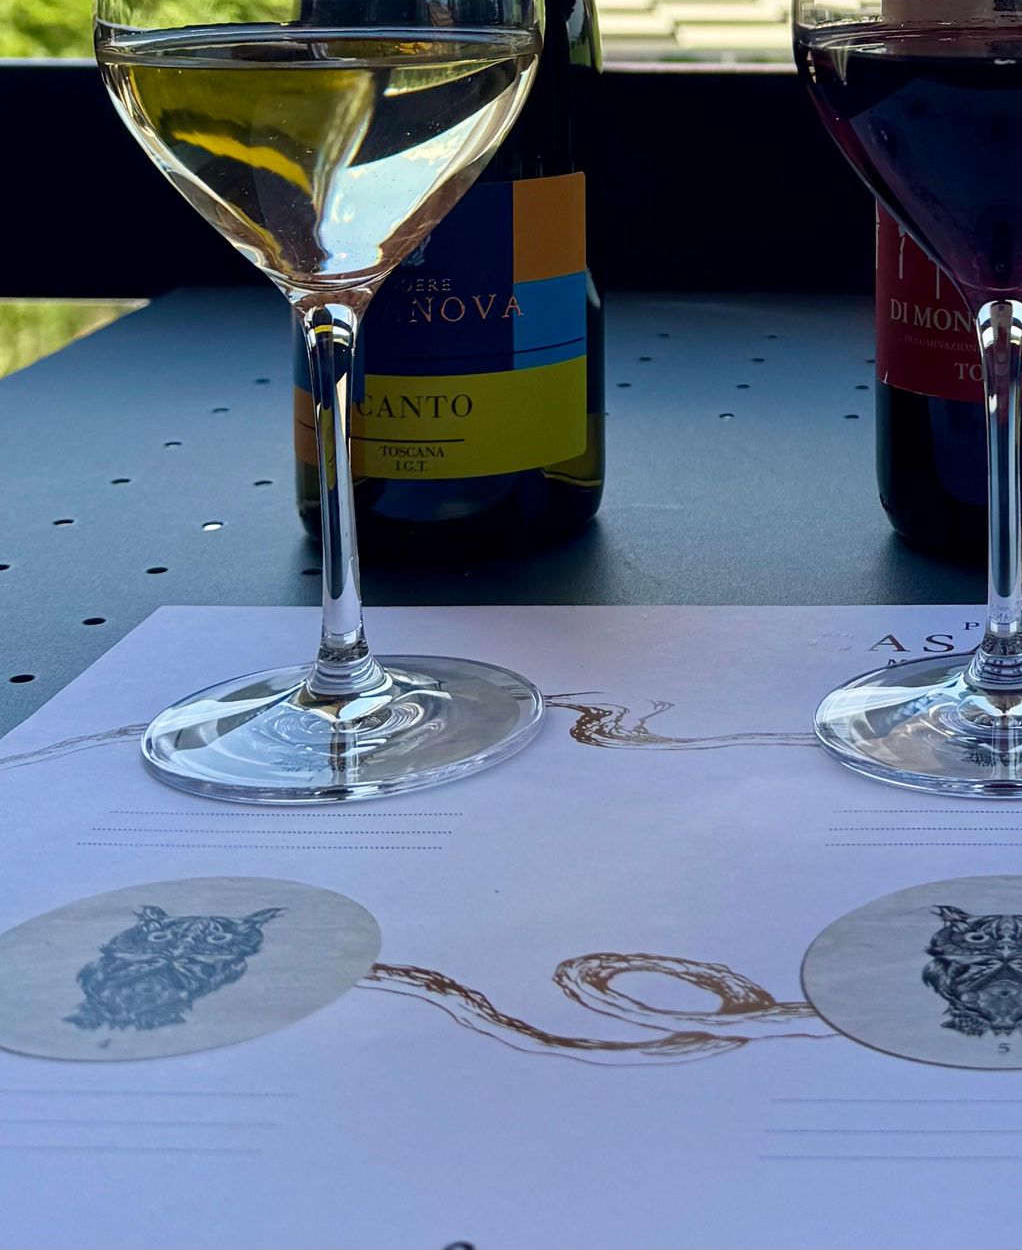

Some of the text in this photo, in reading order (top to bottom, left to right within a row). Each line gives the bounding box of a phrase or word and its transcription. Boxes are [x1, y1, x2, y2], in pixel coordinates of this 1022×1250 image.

[409, 293, 524, 323] NOVA
[890, 298, 908, 323] DI
[380, 445, 445, 459] TOSCANA
